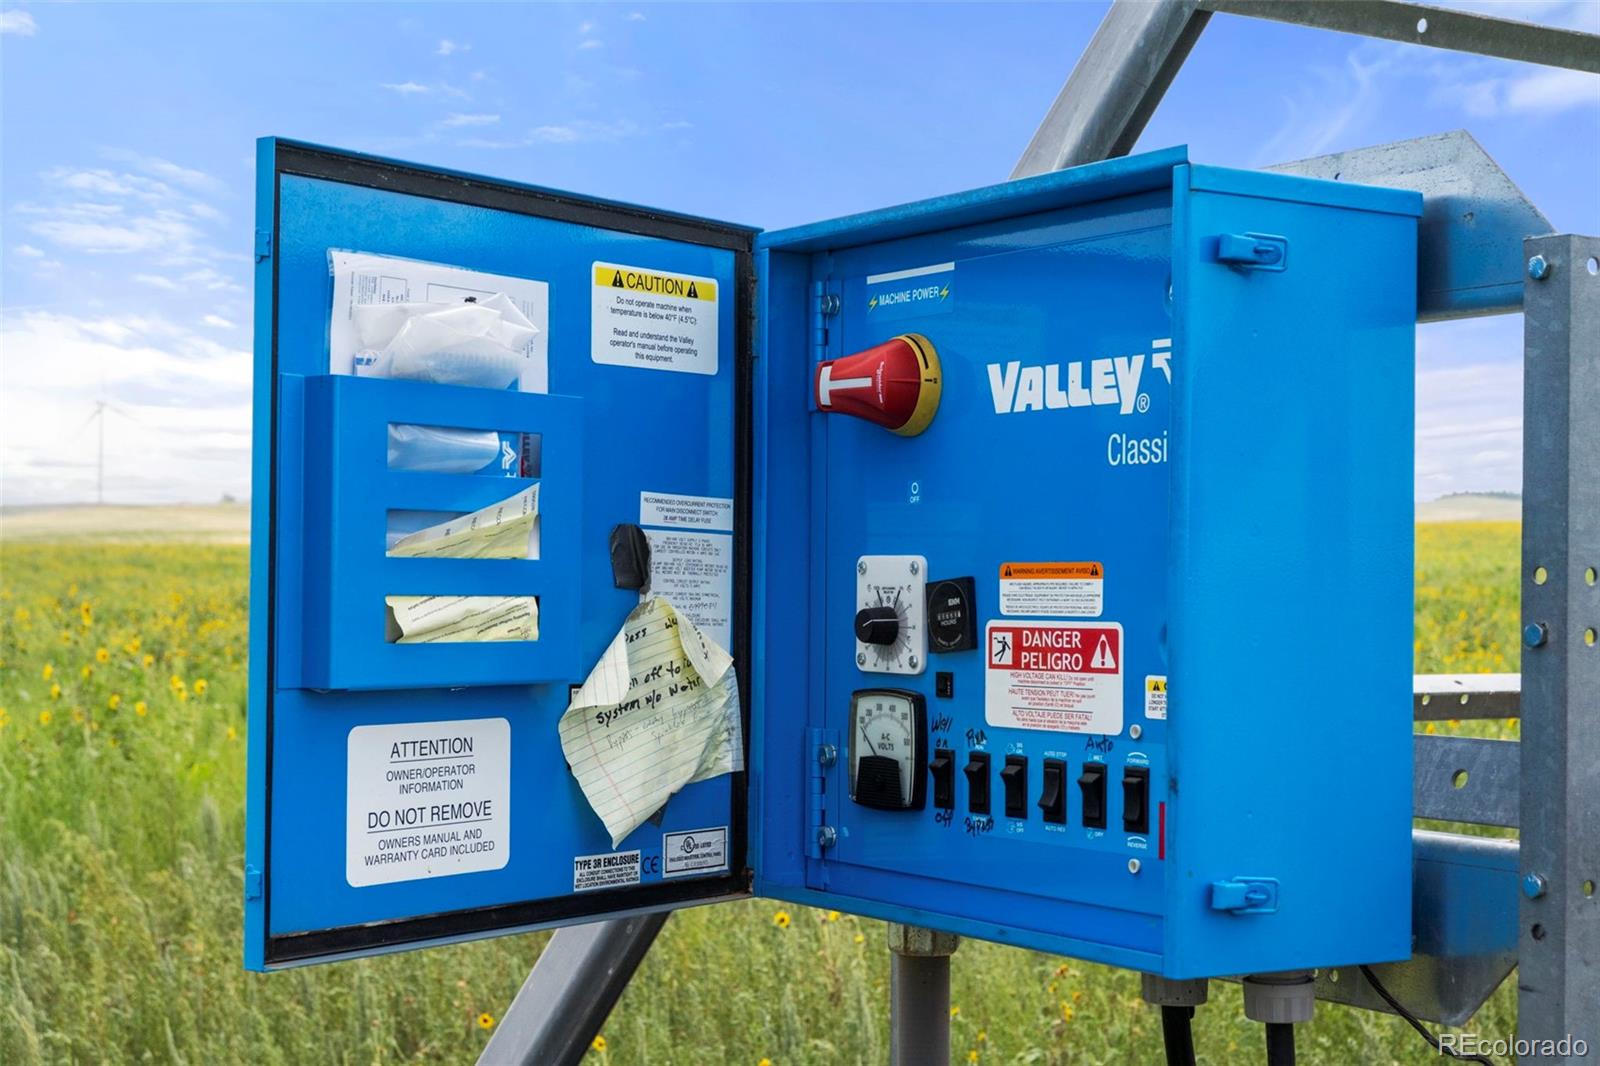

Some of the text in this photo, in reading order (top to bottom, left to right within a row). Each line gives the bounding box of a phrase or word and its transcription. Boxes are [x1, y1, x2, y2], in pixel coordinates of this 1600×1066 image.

[626, 273, 683, 295] CAUTION
[617, 296, 624, 304] Do
[635, 300, 654, 309] operate
[656, 302, 677, 311] machine
[678, 305, 692, 313] when
[880, 286, 939, 306] MACHINE POWER
[611, 307, 642, 318] temperature
[649, 312, 663, 320] below
[613, 328, 627, 336] Read
[629, 330, 638, 338] and
[640, 332, 668, 342] understand
[679, 336, 694, 345] Valley
[610, 340, 635, 348] operator's
[674, 347, 698, 357] operating
[635, 352, 644, 360] this
[987, 355, 1145, 414] VALLEY
[1107, 430, 1168, 466] Classi
[1022, 630, 1081, 648] DANGER
[1021, 652, 1083, 671] PELIGRO
[1023, 672, 1044, 680] VOLTAGE
[390, 737, 473, 758] ATTENTION
[878, 743, 894, 751] VOLTS
[1084, 735, 1114, 753] Auto
[386, 764, 475, 782] OWNER/OPERATOR
[399, 779, 463, 794] INFORMATION
[368, 800, 491, 828] DO NOT REMOVE
[378, 828, 482, 850] OWNERS MANUAL AND
[365, 840, 494, 866] WARRANTY CARD INCLUDED
[575, 854, 639, 872] TYPE 3R ENCLOSURE
